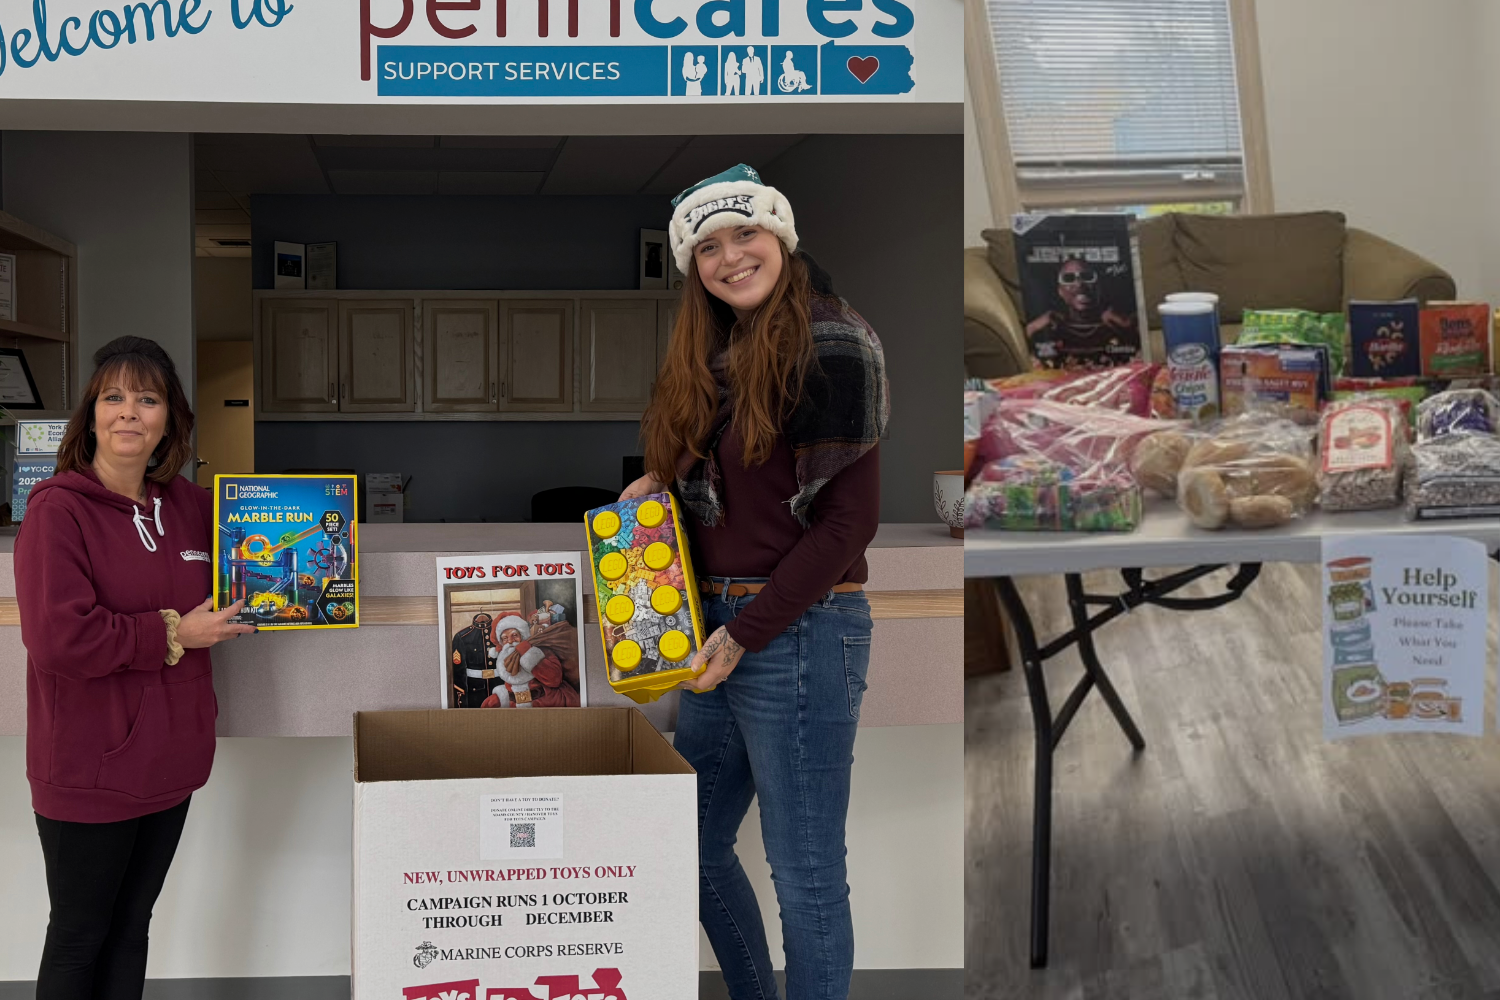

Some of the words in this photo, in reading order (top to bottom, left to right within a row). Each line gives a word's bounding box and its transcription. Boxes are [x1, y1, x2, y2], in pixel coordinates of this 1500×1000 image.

[0, 0, 212, 77] elcome
[384, 62, 500, 80] SUPPORT
[505, 62, 620, 80] SERVICES
[325, 488, 348, 496] STEM
[227, 512, 283, 522] MARBLE
[286, 512, 313, 522] RUN
[326, 514, 338, 522] 50
[639, 506, 660, 521] LEGO
[596, 516, 616, 530] LEGO
[646, 548, 668, 562] LEGO
[443, 566, 486, 579] TOYS
[492, 565, 530, 577] FOR
[534, 563, 575, 575] TOTS
[602, 558, 624, 572] LEGO
[1403, 567, 1456, 592] Help
[654, 590, 676, 605] LEGO
[1382, 587, 1477, 608] Yourself
[608, 601, 630, 615] LEGO
[1394, 617, 1431, 628] Please
[1436, 619, 1463, 629] Take
[662, 637, 685, 652] LEGO
[1399, 637, 1429, 647] What
[1435, 637, 1456, 648] You
[616, 646, 637, 661] LEGO
[1413, 656, 1442, 665] Need
[403, 871, 443, 885] NEW,
[447, 868, 546, 883] UNWRAPPED
[550, 866, 591, 879] TOYS
[594, 866, 637, 878] ONLY
[407, 896, 492, 911] CAMPAIGN
[496, 894, 537, 908] RUNS
[542, 894, 548, 906] 1
[552, 892, 628, 905] OCTOBER
[422, 914, 503, 929] THROUGH
[526, 911, 614, 925] DECEMBER
[440, 947, 501, 960] MARINE
[505, 945, 553, 958] CORPS
[557, 942, 624, 956] RESERVE
